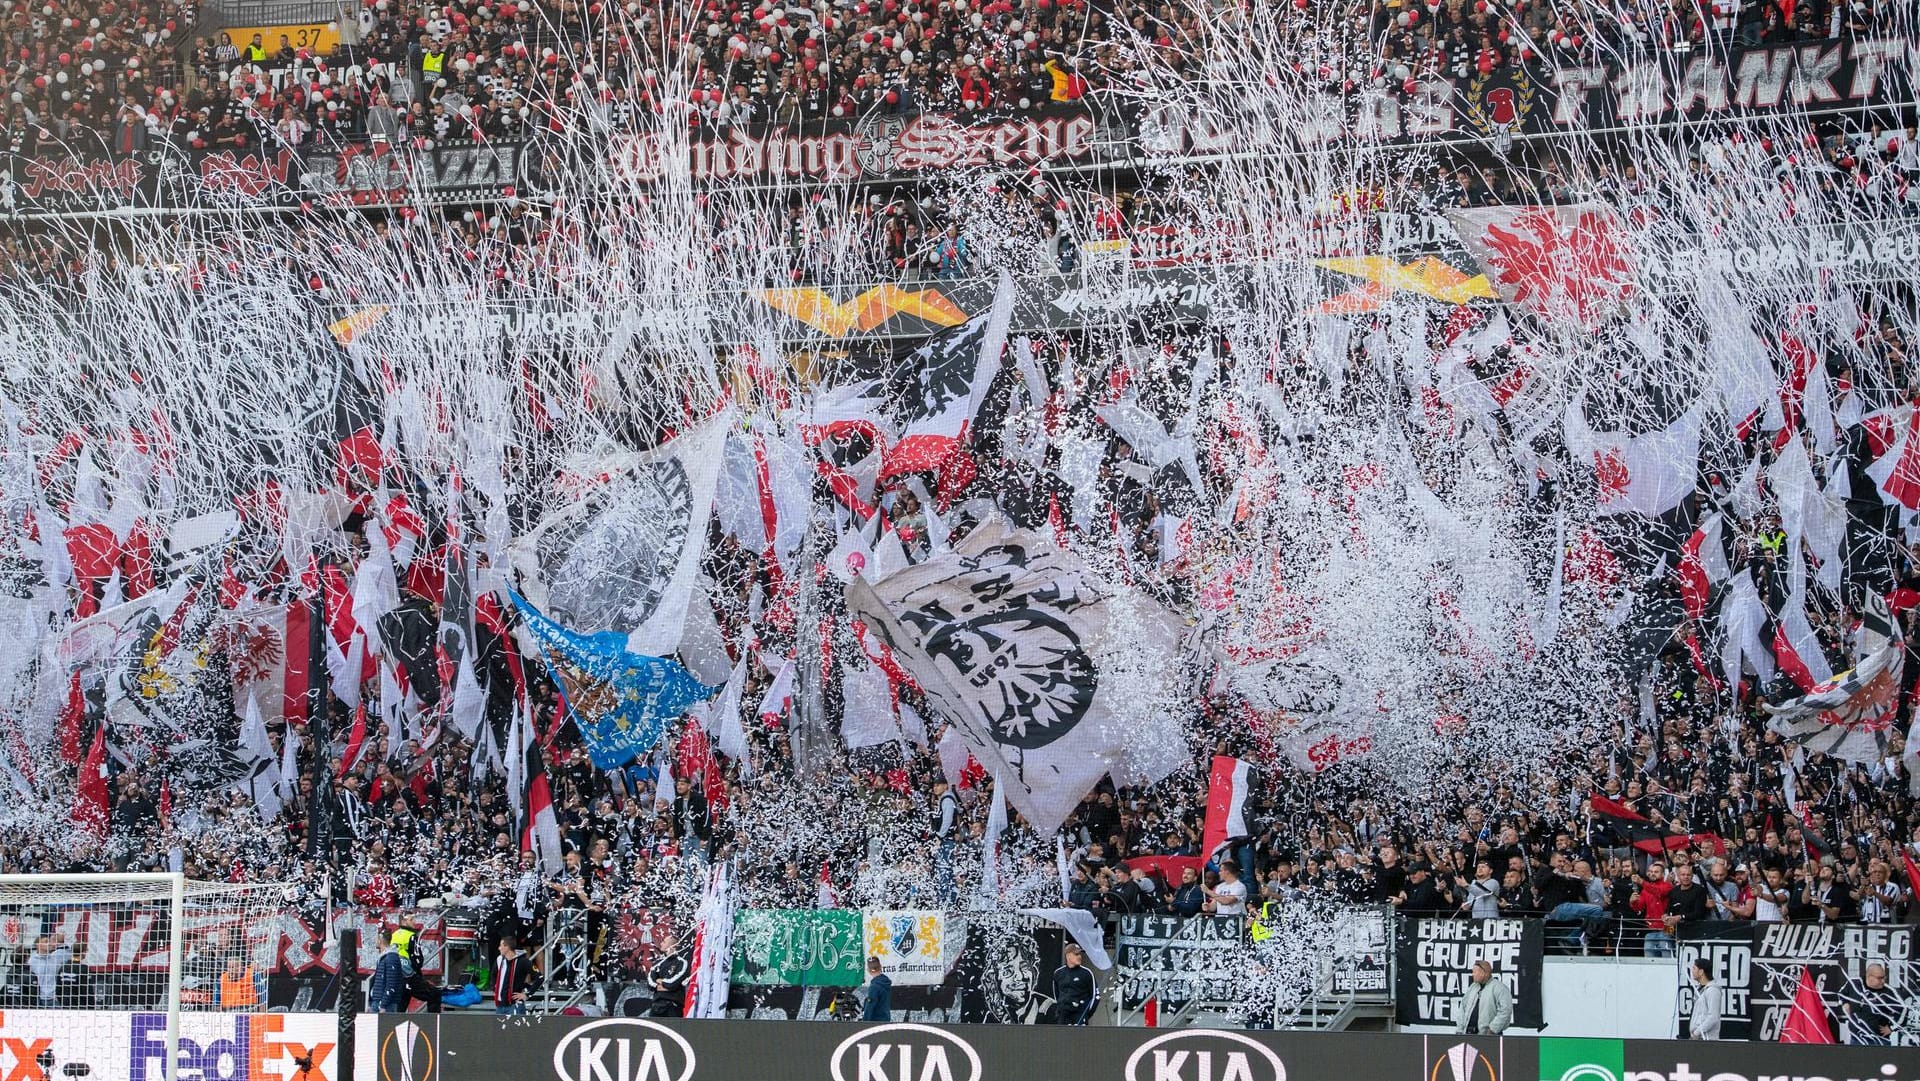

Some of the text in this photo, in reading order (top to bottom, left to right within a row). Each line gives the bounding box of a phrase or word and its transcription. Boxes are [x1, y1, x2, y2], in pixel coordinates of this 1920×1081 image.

[297, 28, 321, 48] 37
[1139, 78, 1456, 151] ULRAS
[894, 112, 1093, 170] Szene
[780, 920, 863, 972] 1964
[1417, 918, 1523, 942] EHRE DER
[1758, 924, 1834, 958] FULDA
[1416, 941, 1520, 972] GRUPPE
[1417, 969, 1519, 996] STADN
[1417, 994, 1519, 1024] VER
[1679, 987, 1751, 1016] GIET
[130, 1012, 338, 1081] FedEx
[578, 1037, 671, 1081] KIA
[856, 1043, 953, 1081] KIA
[1152, 1049, 1255, 1081] KIA
